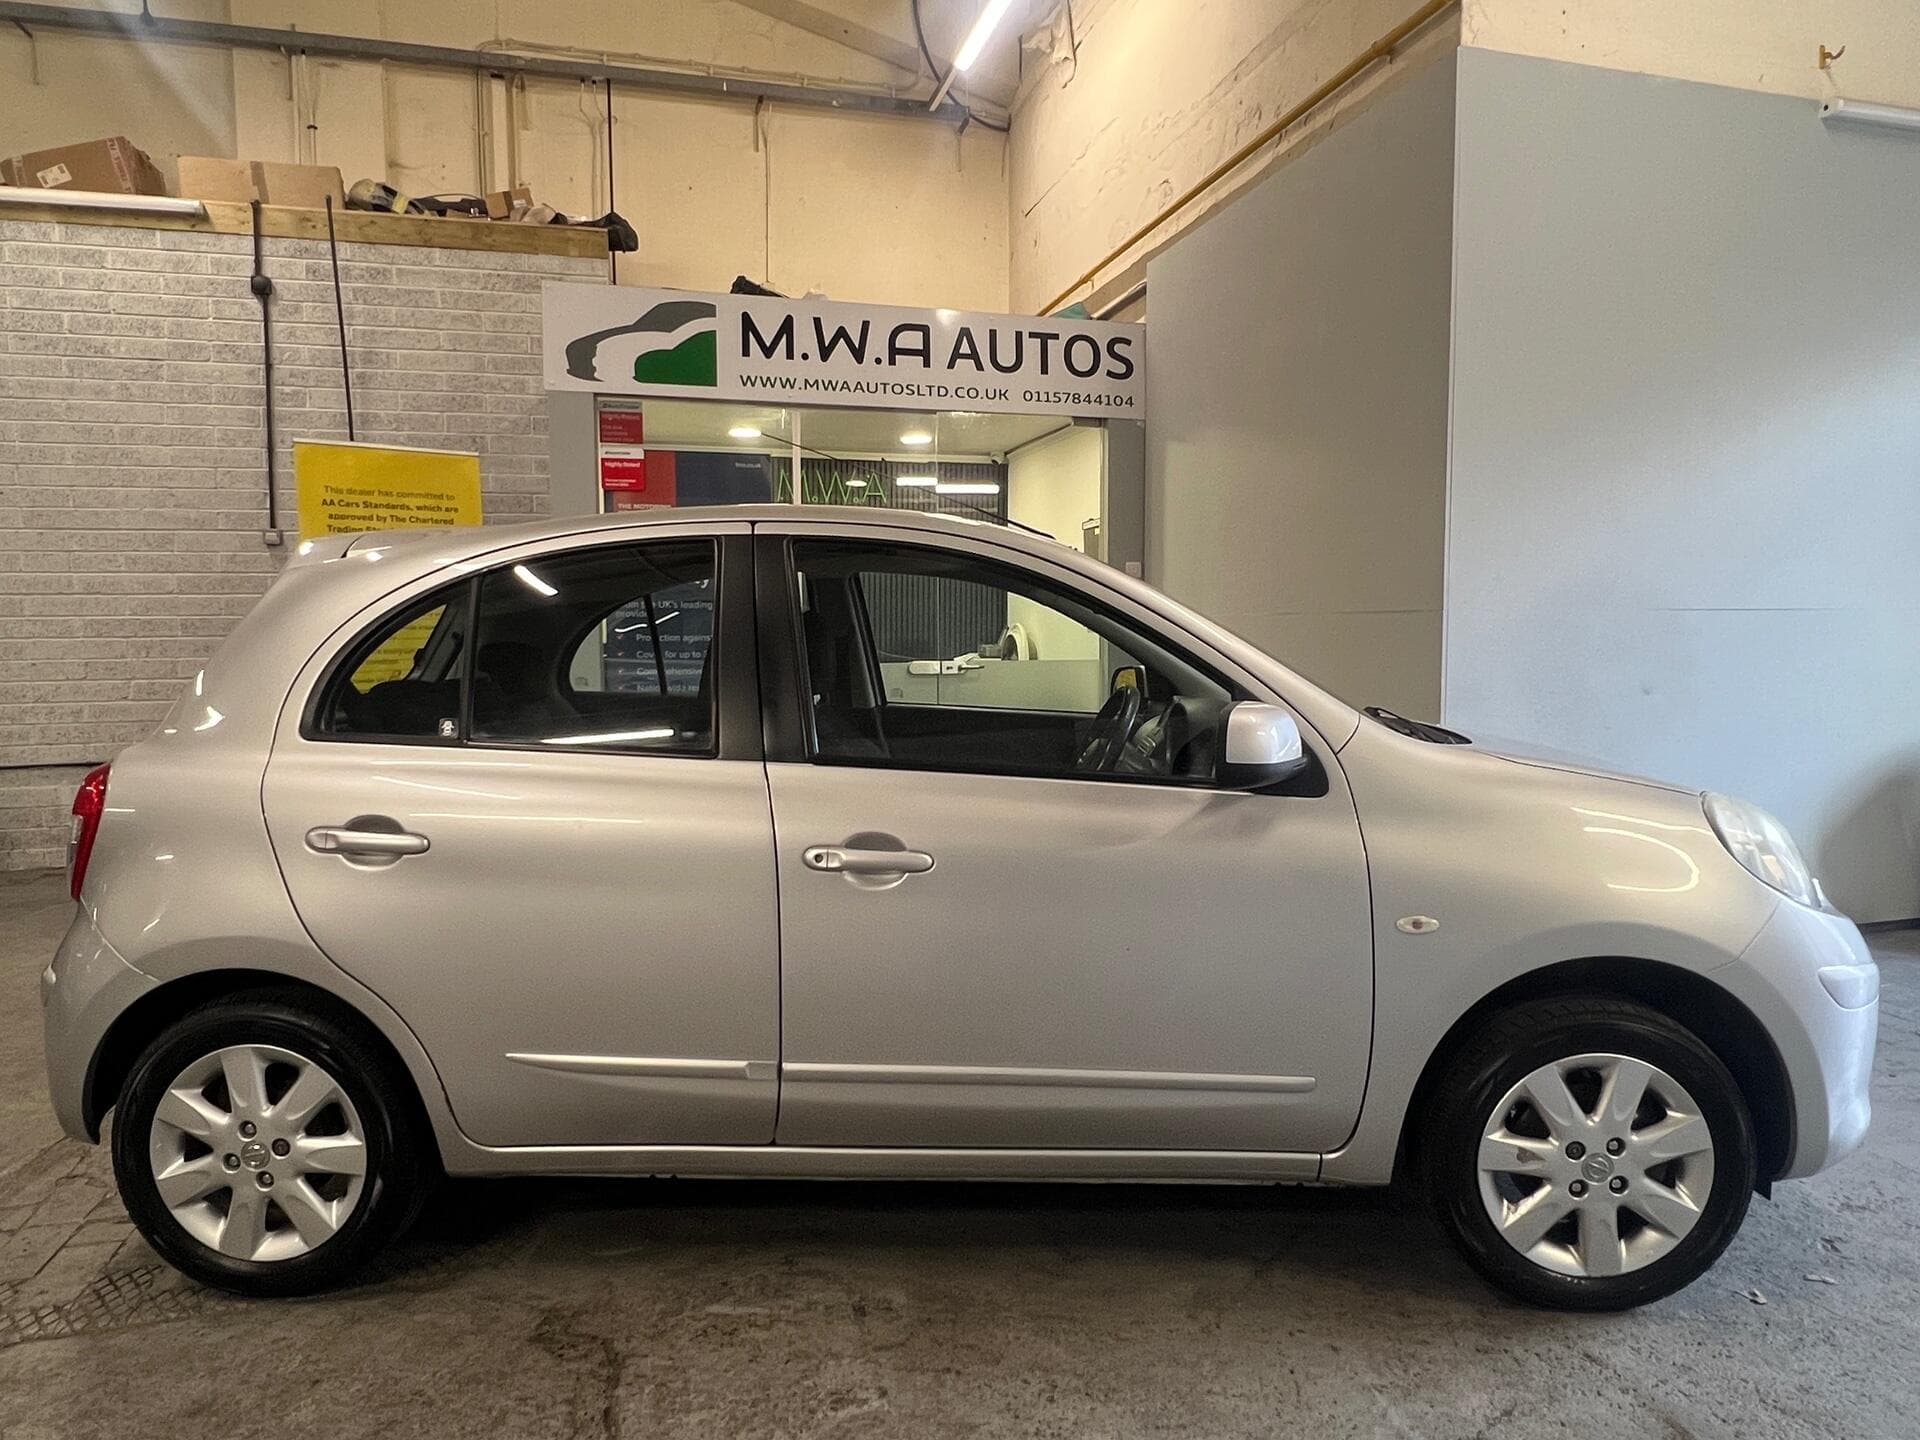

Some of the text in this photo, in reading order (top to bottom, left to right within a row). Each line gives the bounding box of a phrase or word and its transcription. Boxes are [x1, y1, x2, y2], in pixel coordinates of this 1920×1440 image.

[741, 311, 1135, 380] M.W.A AUTOS
[740, 374, 1135, 408] WWW.MWAAUTOSLTD.CO.UK 01157844104
[324, 485, 344, 494] This
[346, 487, 375, 497] dealer
[377, 489, 394, 497] has
[396, 491, 444, 500] committed
[321, 498, 336, 507] AA
[337, 499, 360, 508] Cars
[416, 503, 443, 512] which
[328, 513, 455, 525] approved by The Chartered
[681, 601, 713, 611] leading
[636, 633, 681, 642] Proction
[664, 650, 678, 659] for
[679, 652, 691, 660] up
[692, 651, 702, 659] to
